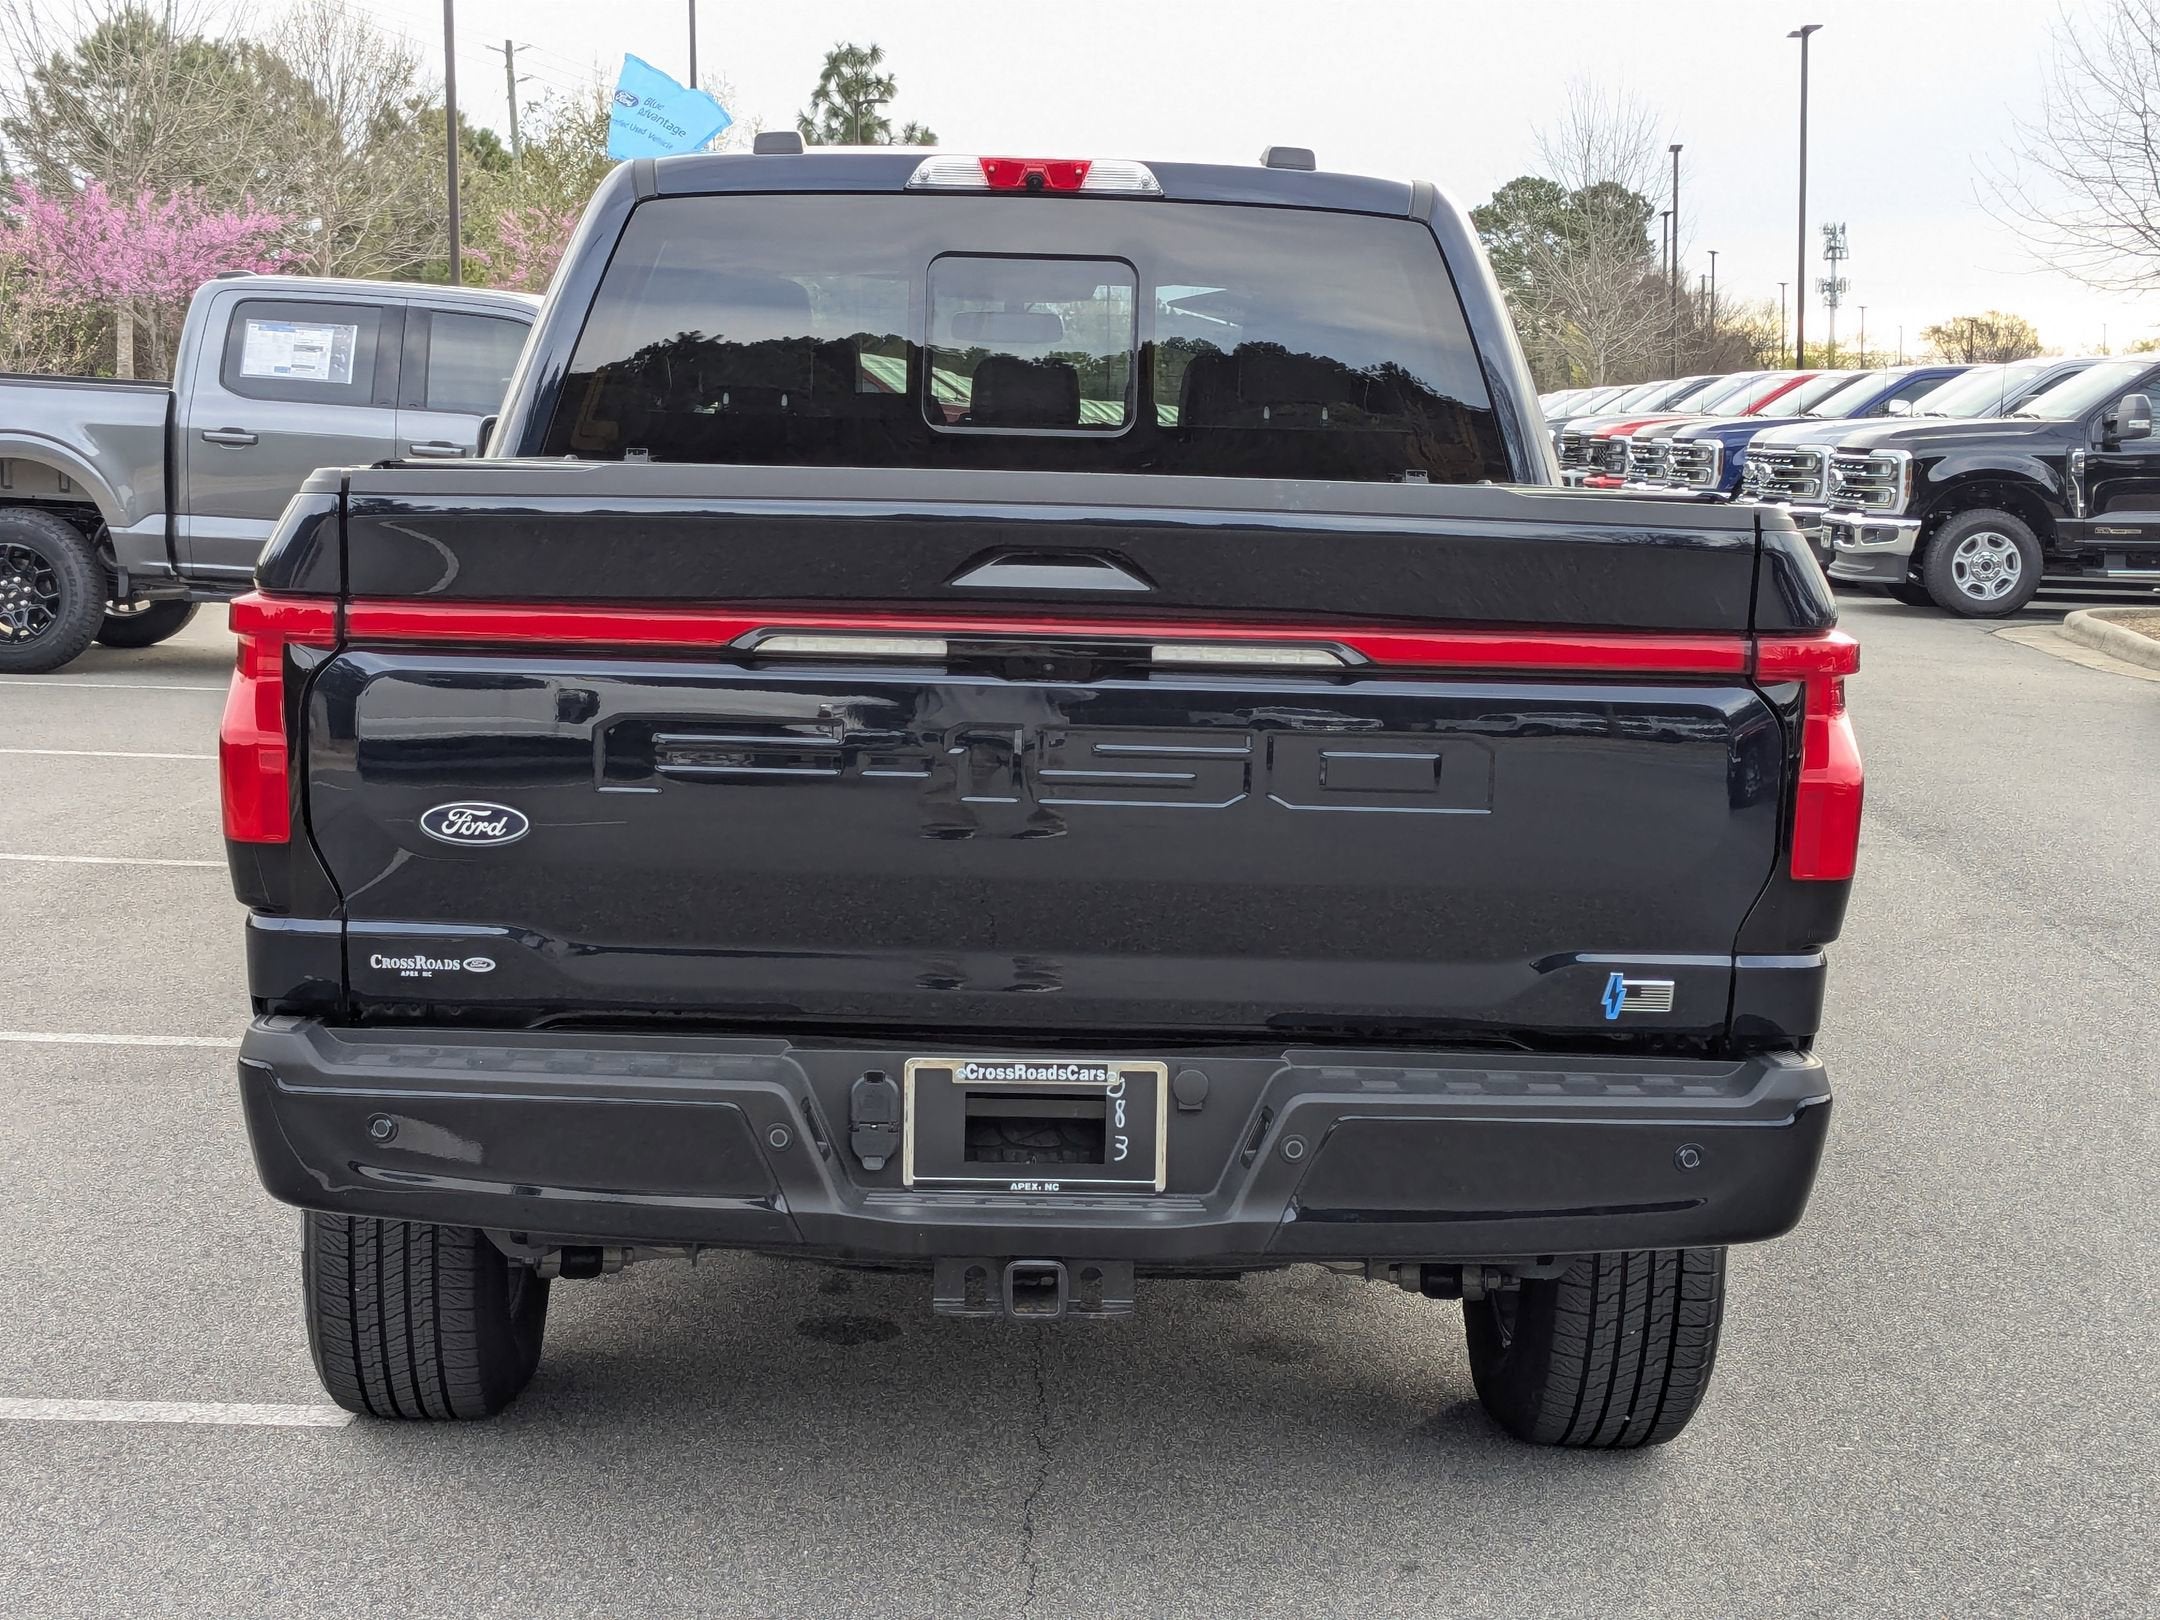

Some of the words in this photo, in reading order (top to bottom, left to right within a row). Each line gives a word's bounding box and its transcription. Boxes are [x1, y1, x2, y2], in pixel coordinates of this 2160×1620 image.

[643, 96, 665, 111] Blue
[637, 107, 687, 138] Advantage
[592, 712, 1495, 815] F-150
[441, 808, 508, 836] Ford
[965, 1063, 1106, 1081] CrossRoadsCars
[1044, 1182, 1060, 1191] NC
